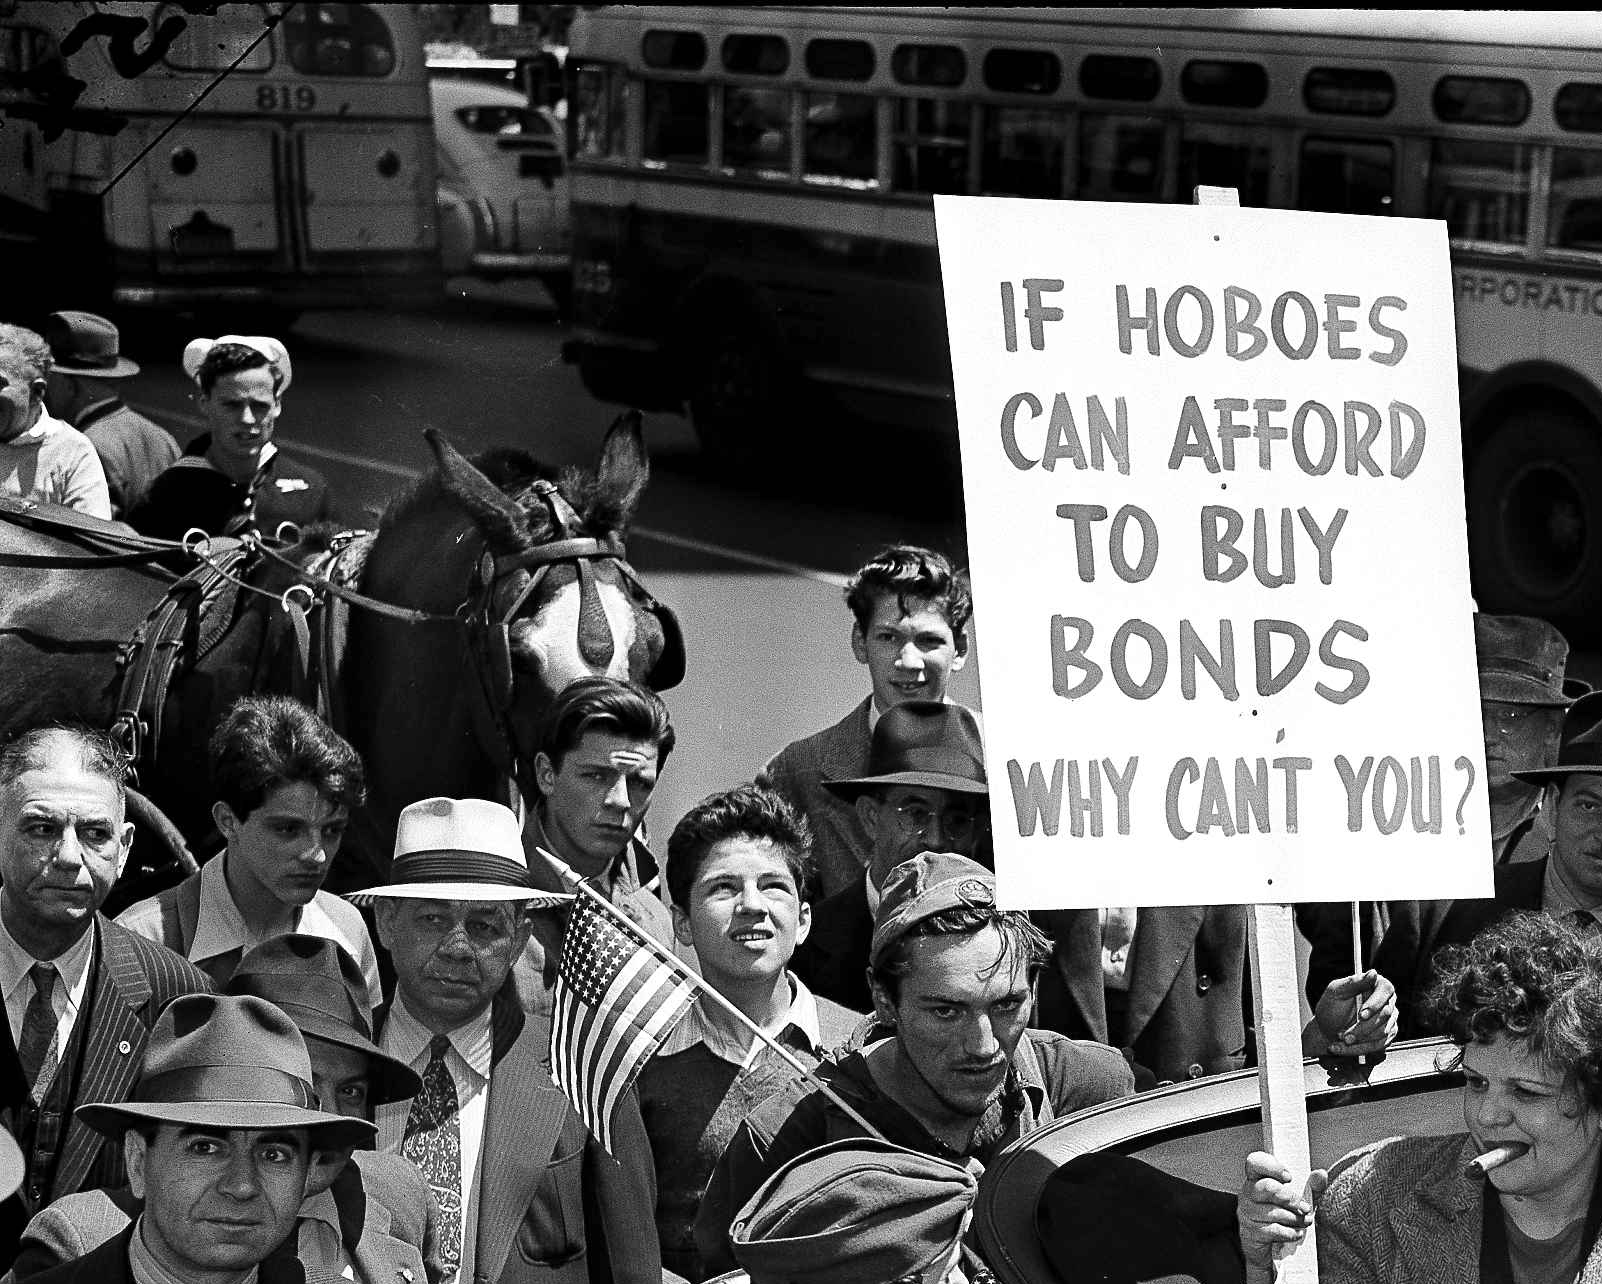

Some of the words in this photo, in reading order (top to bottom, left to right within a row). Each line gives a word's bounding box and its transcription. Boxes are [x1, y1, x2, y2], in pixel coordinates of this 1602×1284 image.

[256, 85, 315, 111] 819
[1000, 278, 1064, 353] IF
[1116, 284, 1408, 366] HOBOES
[1000, 391, 1130, 475] CAN
[1167, 395, 1427, 480] AFFORD
[1056, 503, 1158, 583] TO
[1201, 505, 1348, 588] BUY
[1050, 613, 1371, 705] BONDS
[1007, 755, 1139, 838] WHY
[1166, 728, 1312, 841] CAN'T
[1334, 755, 1475, 837] YOU?
